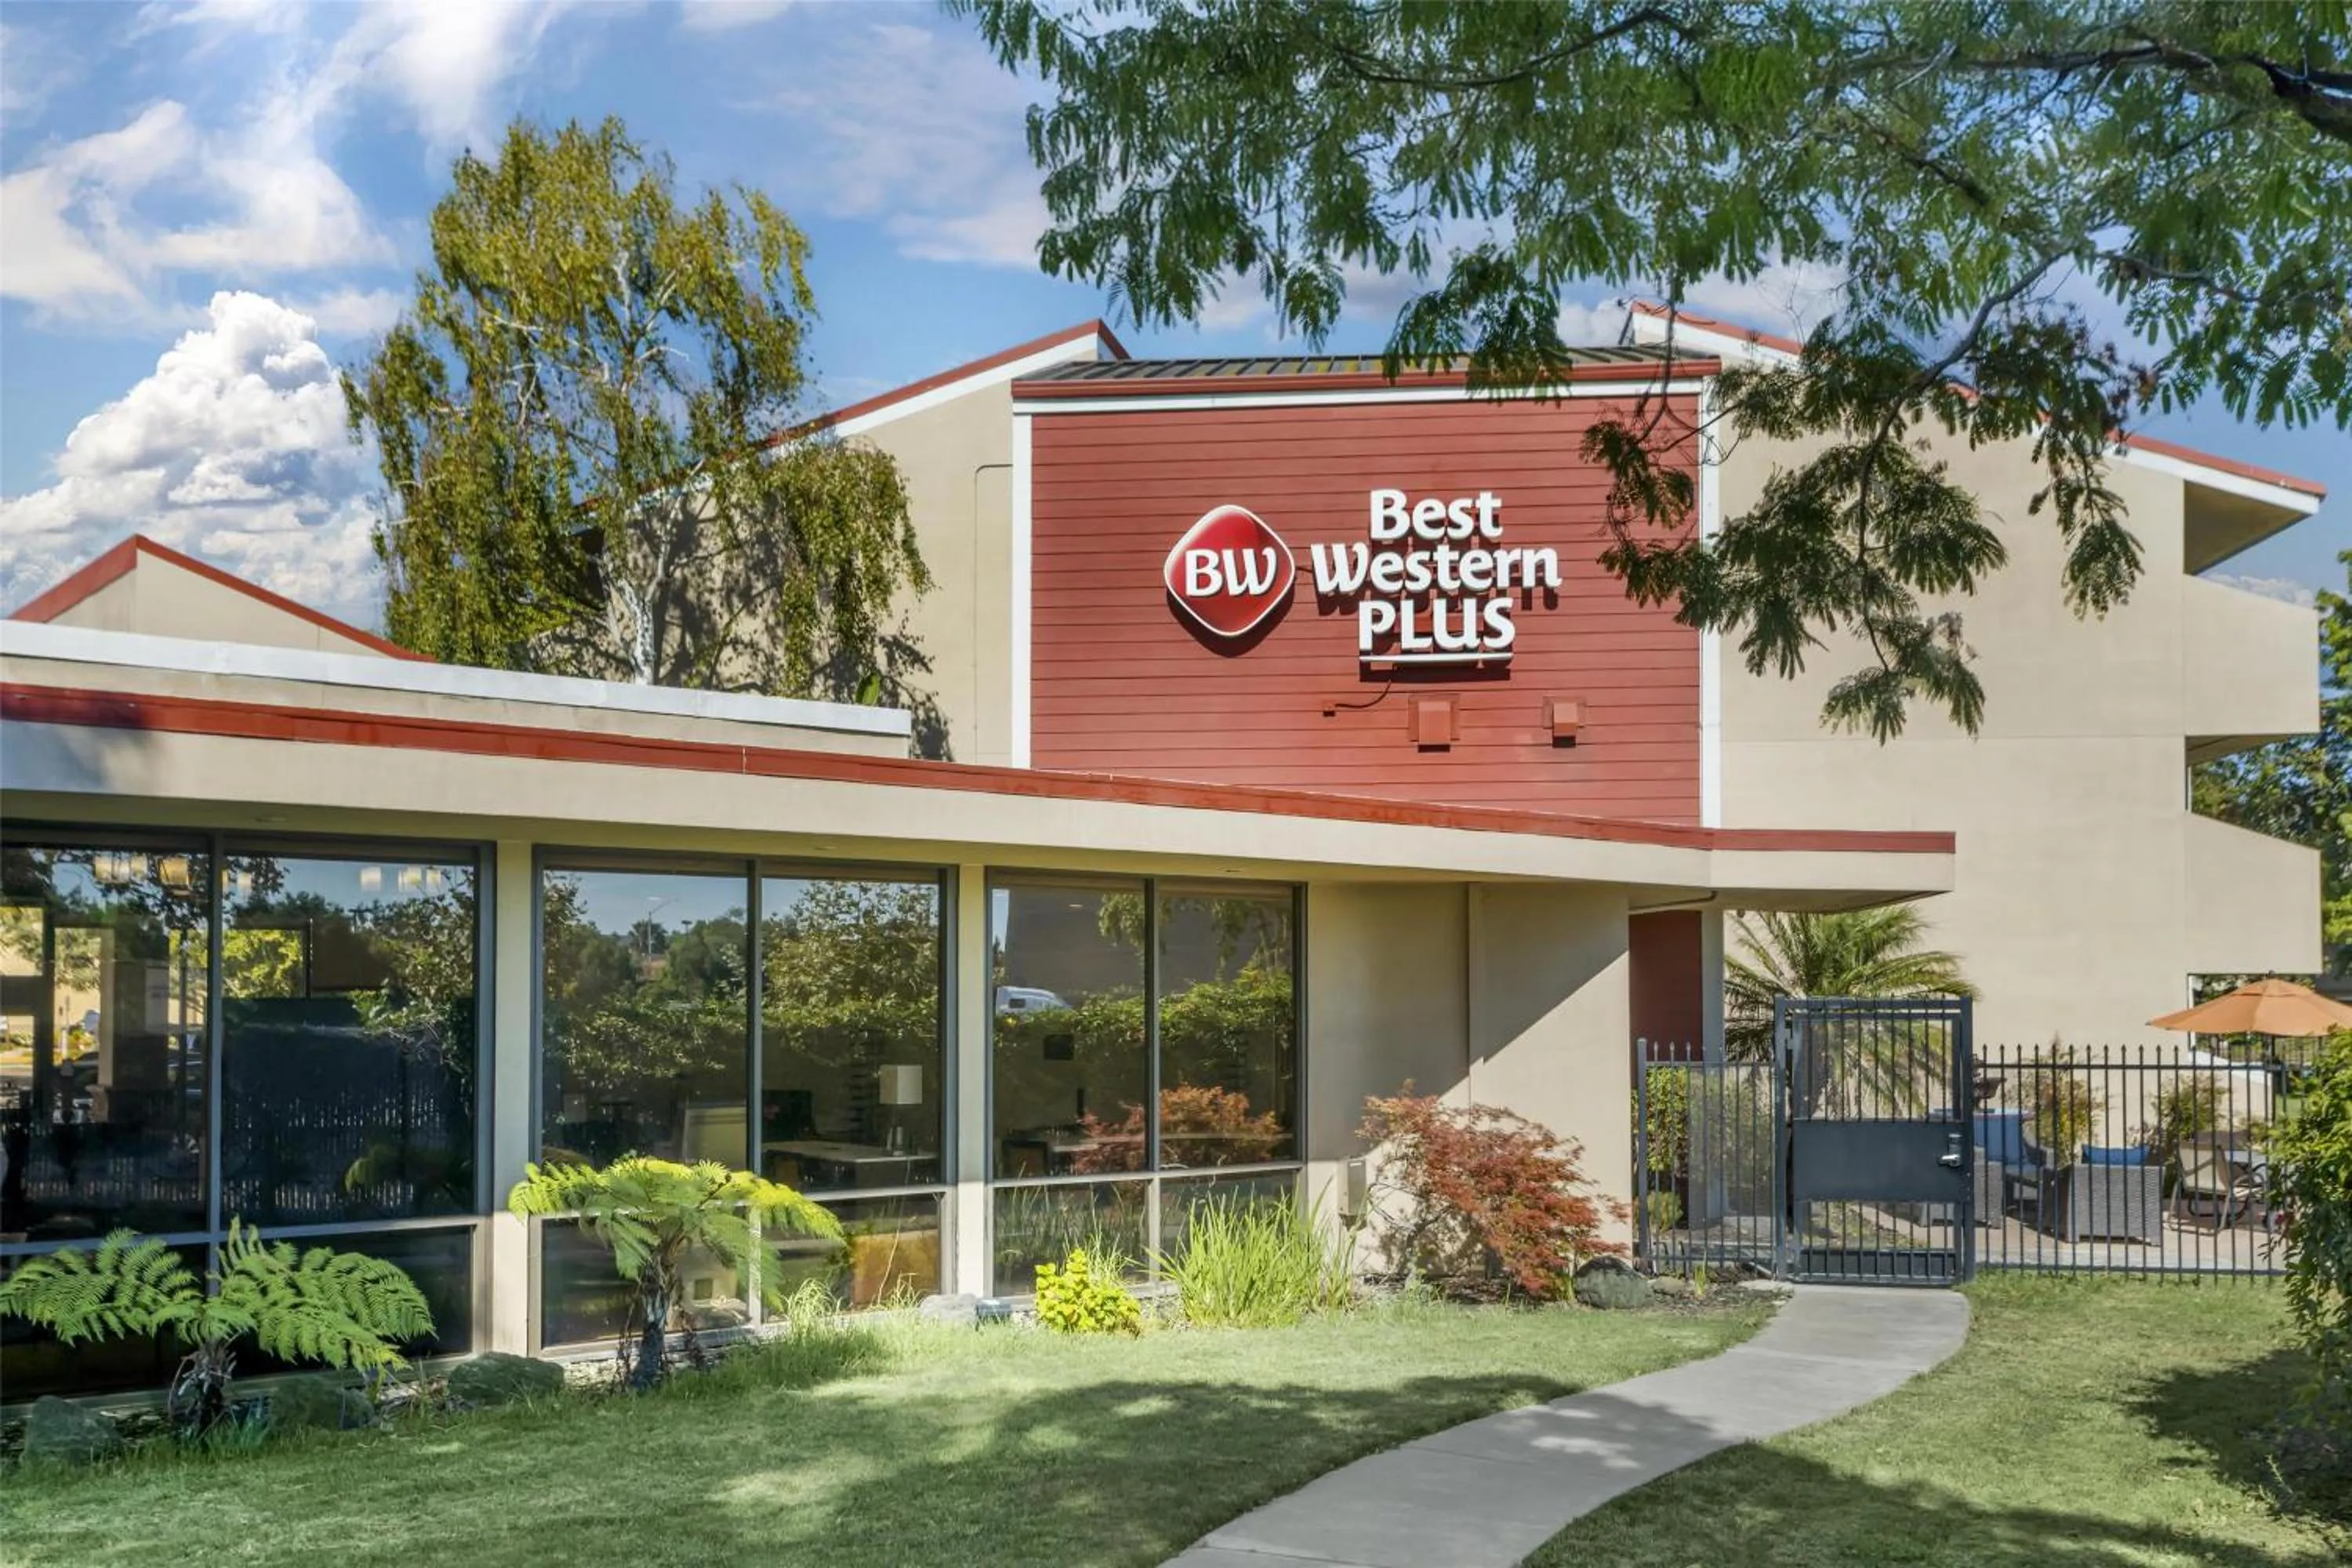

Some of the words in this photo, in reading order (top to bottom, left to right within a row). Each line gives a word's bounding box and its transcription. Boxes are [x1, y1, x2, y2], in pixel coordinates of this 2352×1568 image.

[1370, 489, 1504, 540] Best
[1185, 547, 1278, 597] BW
[1311, 543, 1563, 593] Western
[1359, 597, 1515, 651] PLUS
